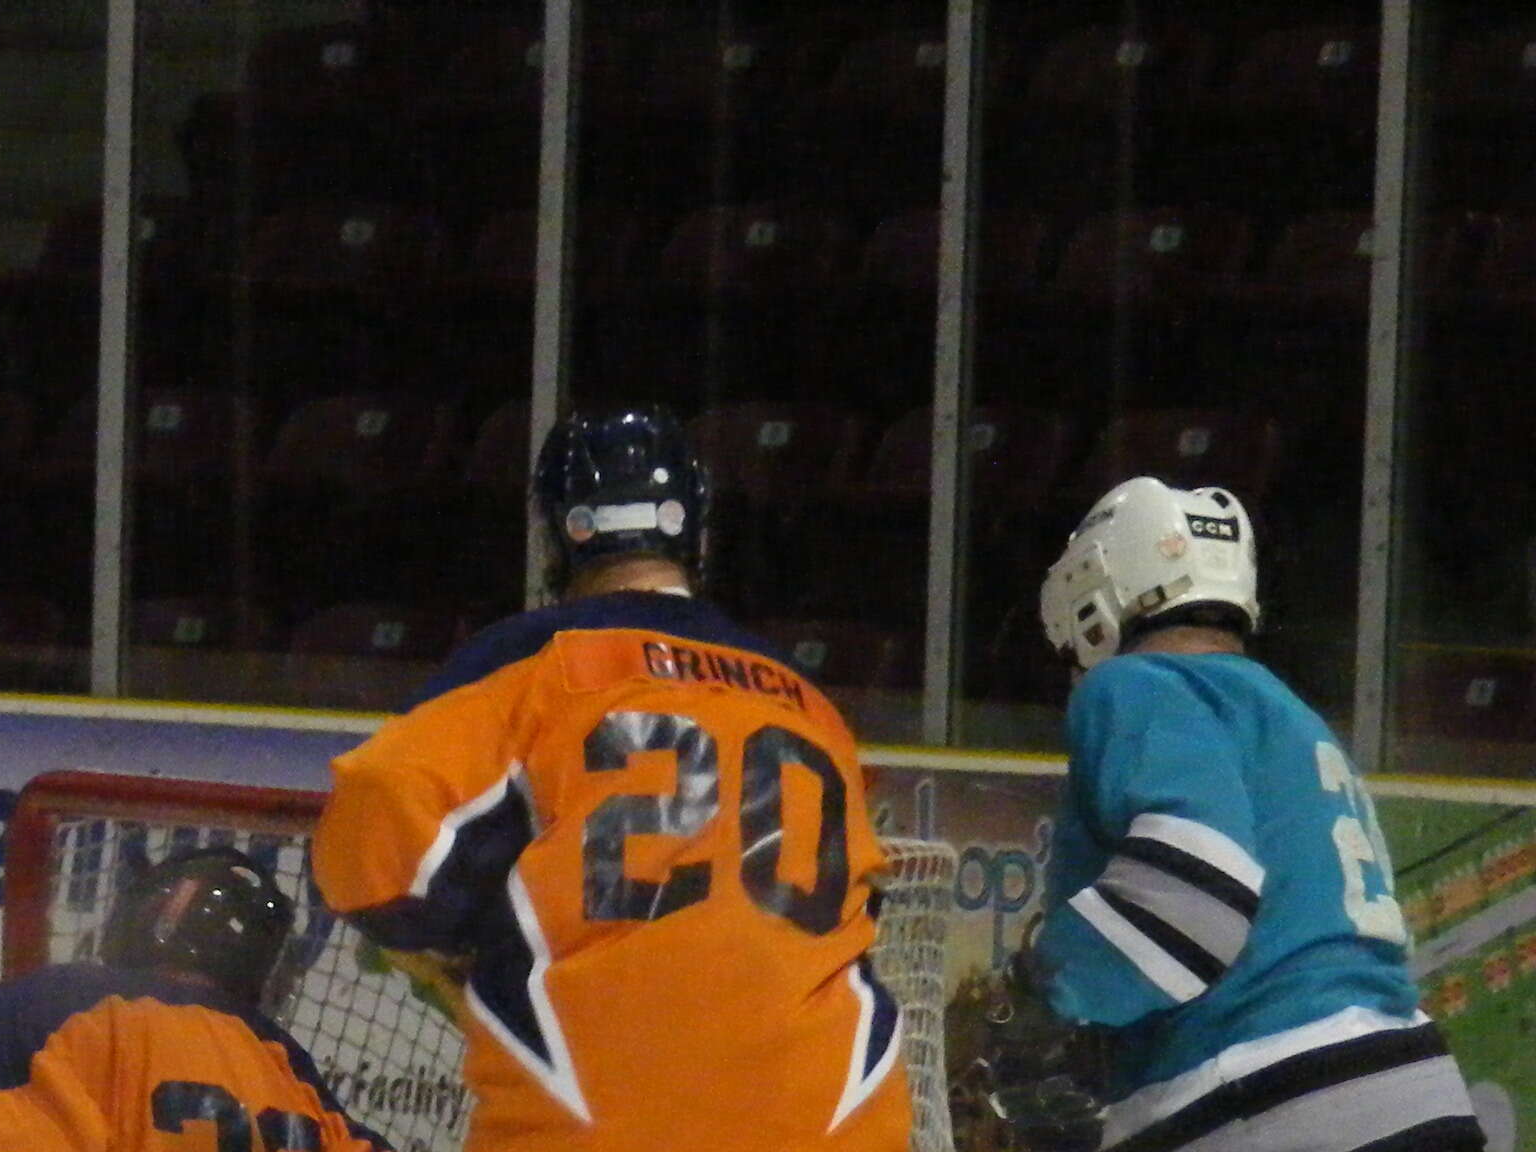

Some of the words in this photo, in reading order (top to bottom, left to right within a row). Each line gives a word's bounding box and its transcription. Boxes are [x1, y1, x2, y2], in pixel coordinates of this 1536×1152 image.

[1191, 518, 1234, 537] CCM
[642, 641, 806, 712] GRINCH
[582, 711, 850, 936] 20
